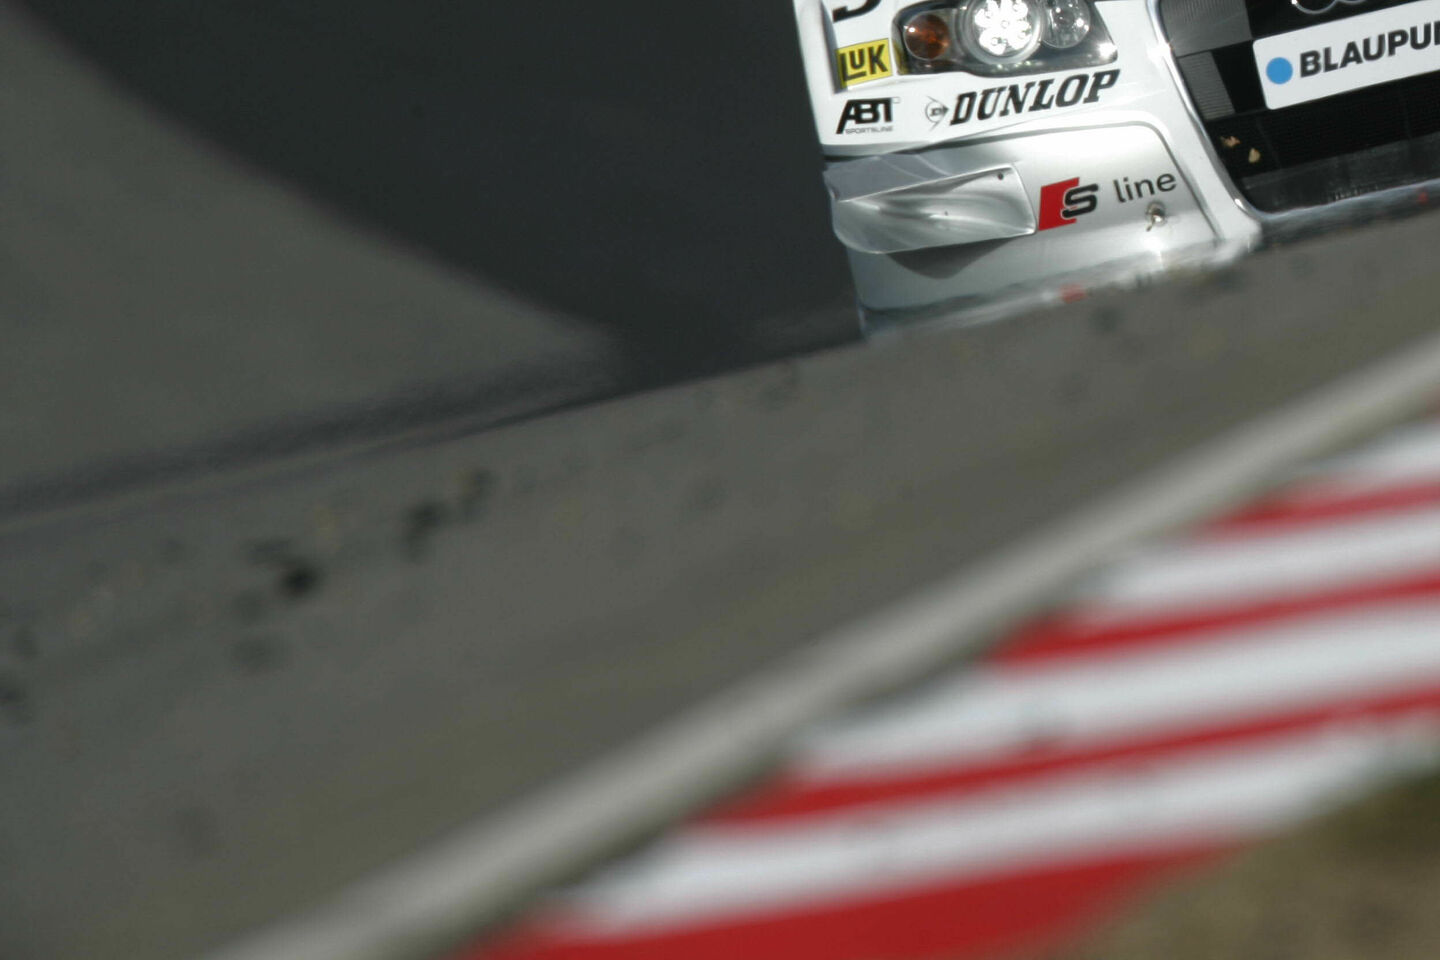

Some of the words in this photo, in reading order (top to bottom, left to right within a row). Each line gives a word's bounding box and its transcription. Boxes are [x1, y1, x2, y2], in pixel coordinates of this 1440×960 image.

[836, 97, 892, 134] ABT
[949, 69, 1120, 126] DUNLOP
[1113, 173, 1177, 203] line
